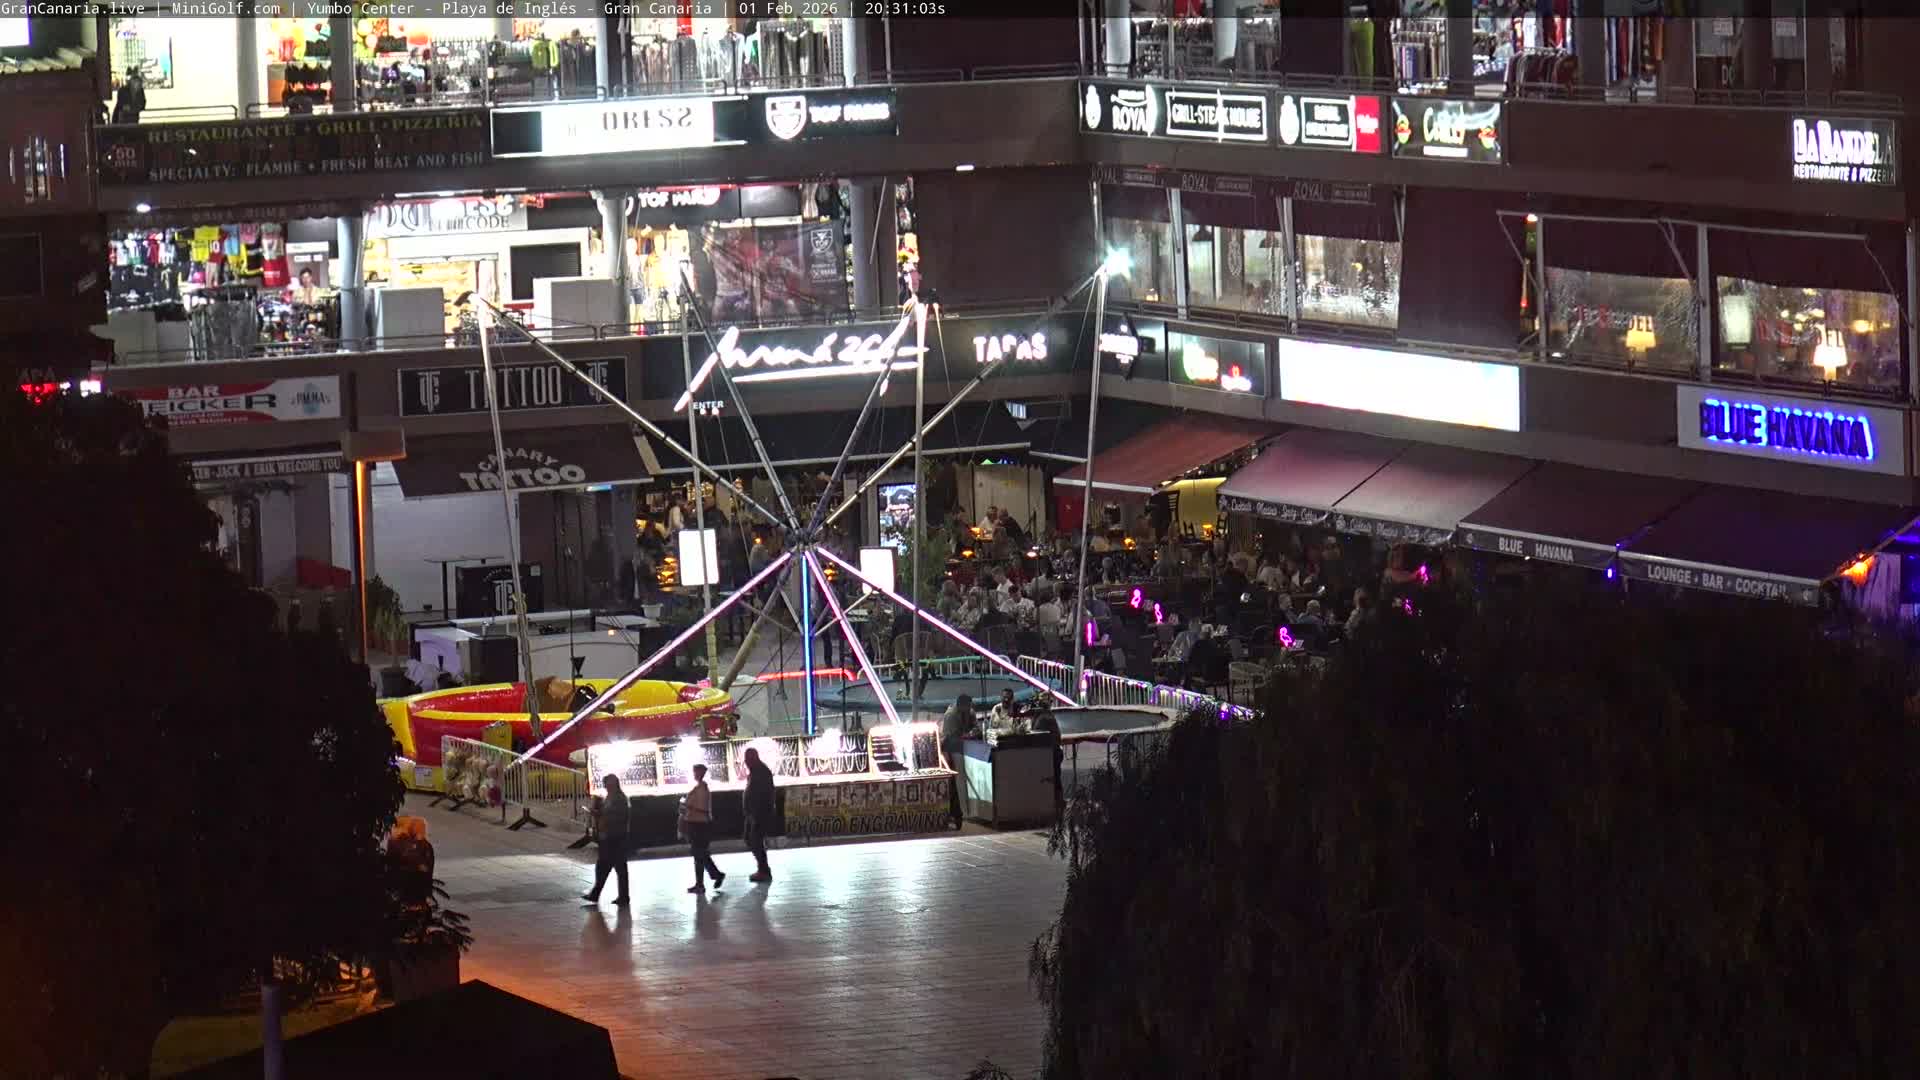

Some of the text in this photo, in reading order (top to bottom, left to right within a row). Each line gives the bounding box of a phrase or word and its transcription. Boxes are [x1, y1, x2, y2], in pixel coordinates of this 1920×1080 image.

[149, 124, 296, 144] RESTAURANTE
[391, 114, 483, 132] PIZZERIA
[321, 158, 367, 173] FRESH
[374, 154, 409, 170] MEAT
[416, 152, 446, 169] AND
[451, 151, 484, 167] FISH
[1793, 163, 1851, 181] RESTAURANTE
[1182, 173, 1210, 192] ROYAL
[1293, 180, 1324, 200] ROYAL
[973, 331, 1048, 363] TAPAS
[168, 385, 220, 399] BAR
[692, 400, 725, 411] ENTER
[1700, 398, 1875, 461] BLUE HAVANA
[277, 458, 322, 475] WELCOME
[323, 456, 342, 471] YOU
[477, 447, 559, 472] CANARY
[459, 463, 587, 492] TATTOO
[1498, 536, 1575, 563] BLUE HAVANA
[1646, 563, 1692, 584] LOUNGE
[1701, 571, 1725, 591] BAR
